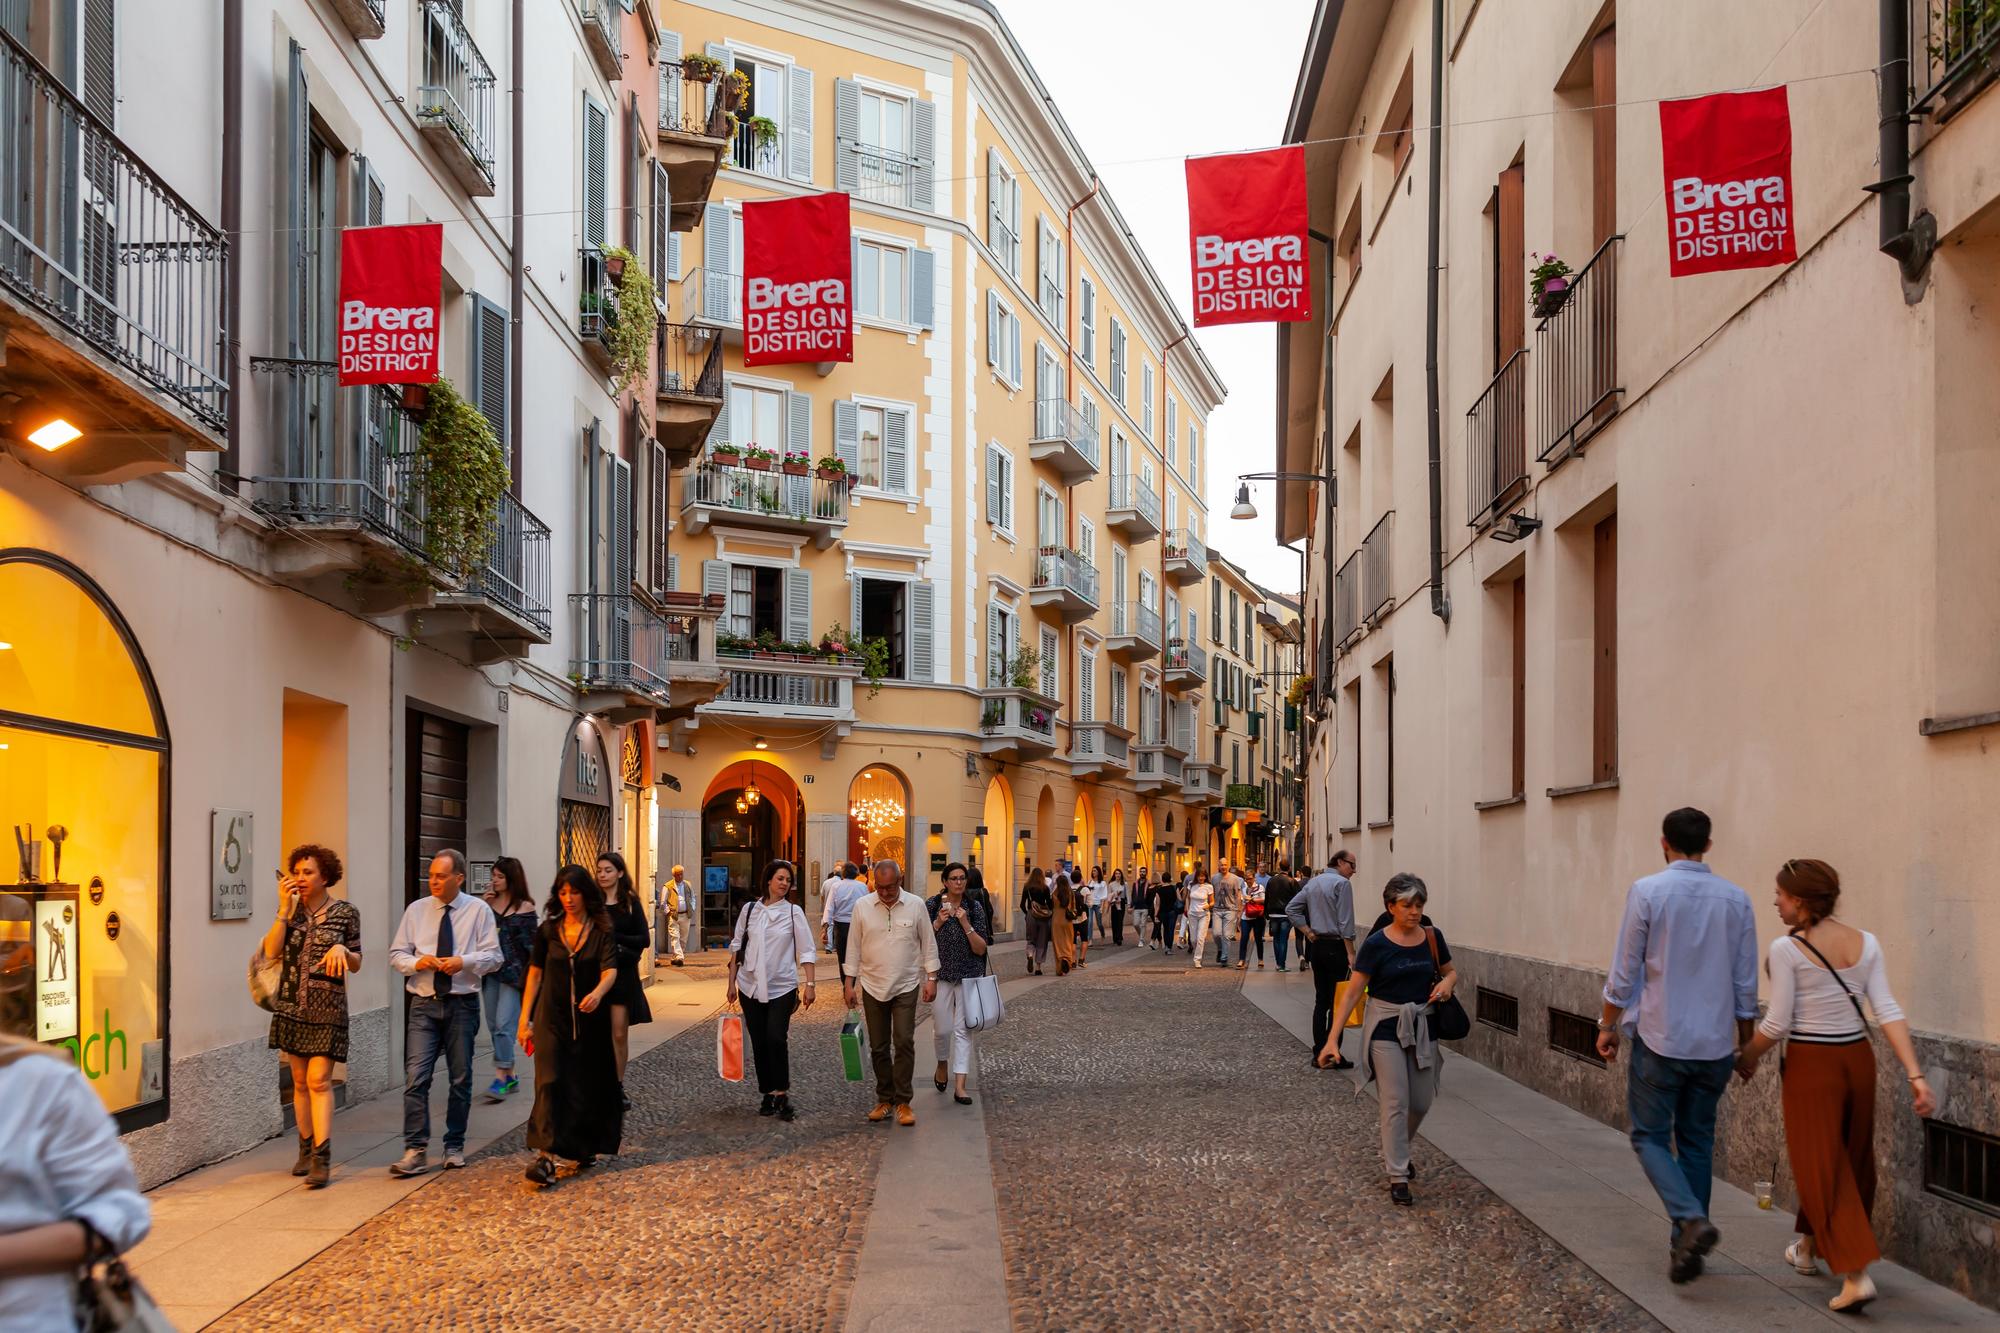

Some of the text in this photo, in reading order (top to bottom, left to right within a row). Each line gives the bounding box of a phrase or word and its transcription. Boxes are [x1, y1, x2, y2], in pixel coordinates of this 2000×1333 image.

[1672, 176, 1785, 214] Brera
[1674, 207, 1787, 238] DESIGN
[1196, 234, 1302, 268] Brera
[1676, 230, 1787, 261] DISTRICT
[1197, 265, 1303, 291] DESIGN
[748, 277, 845, 310] Brera
[1198, 287, 1303, 314] DISTRICT
[343, 300, 434, 331] Brera
[748, 307, 847, 332] DESIGN
[342, 332, 434, 353] DESIGN
[748, 329, 846, 354] DISTRICT
[342, 352, 432, 373] DISTRICT
[805, 775, 813, 783] 17
